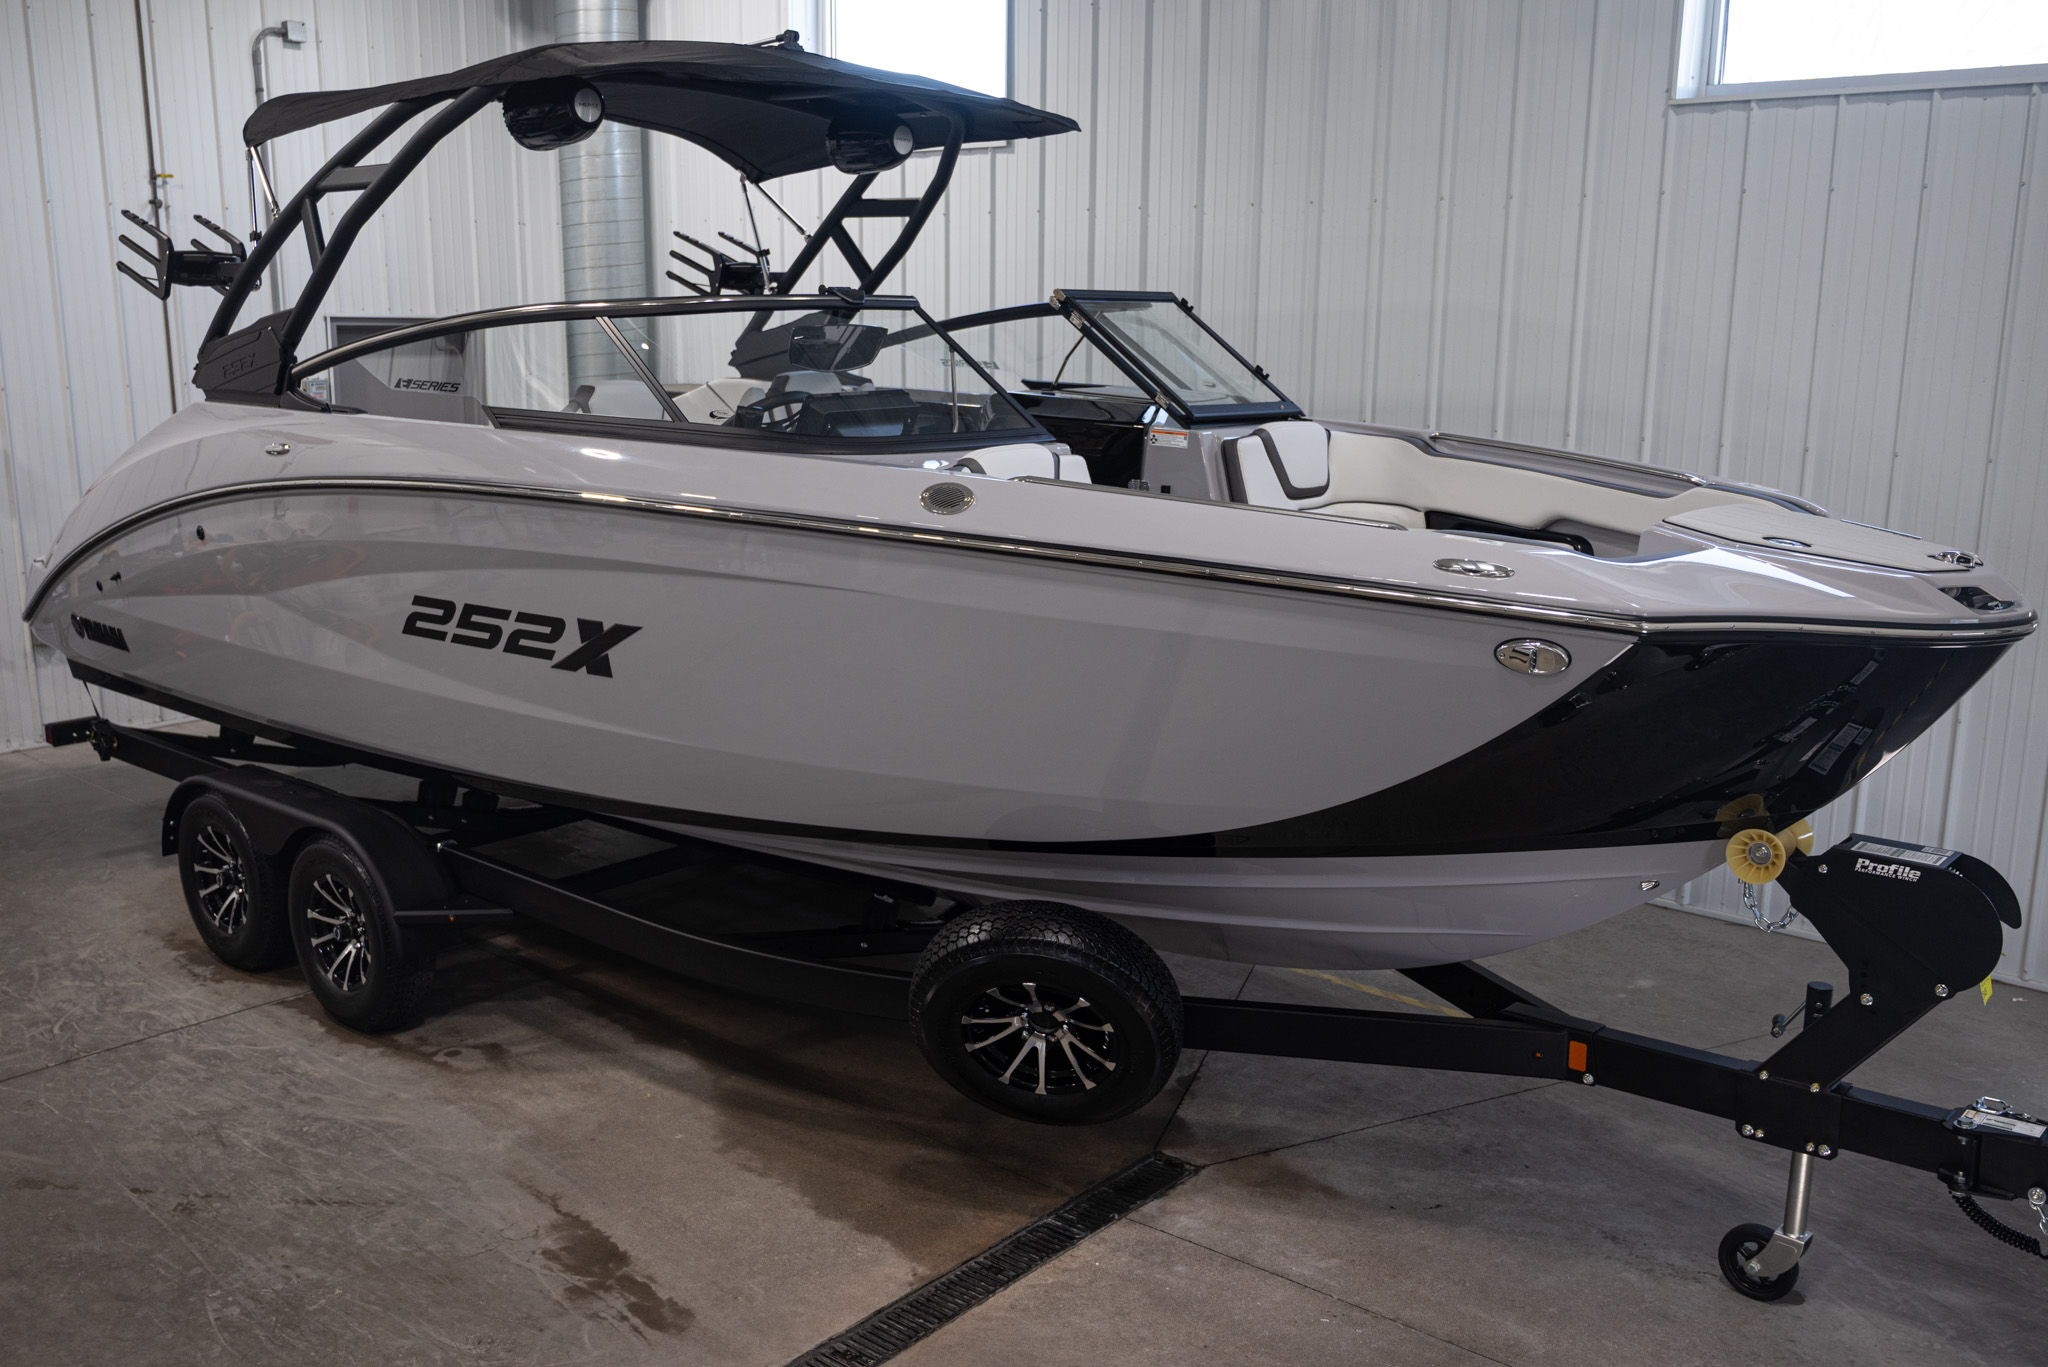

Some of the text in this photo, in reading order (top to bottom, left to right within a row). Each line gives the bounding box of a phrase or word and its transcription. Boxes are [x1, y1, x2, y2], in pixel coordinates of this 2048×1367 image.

[411, 380, 461, 393] SERIES
[402, 595, 643, 678] 252X
[1854, 867, 1918, 883] PERFORMANCE WINCH
[1855, 858, 1922, 879] Profile
